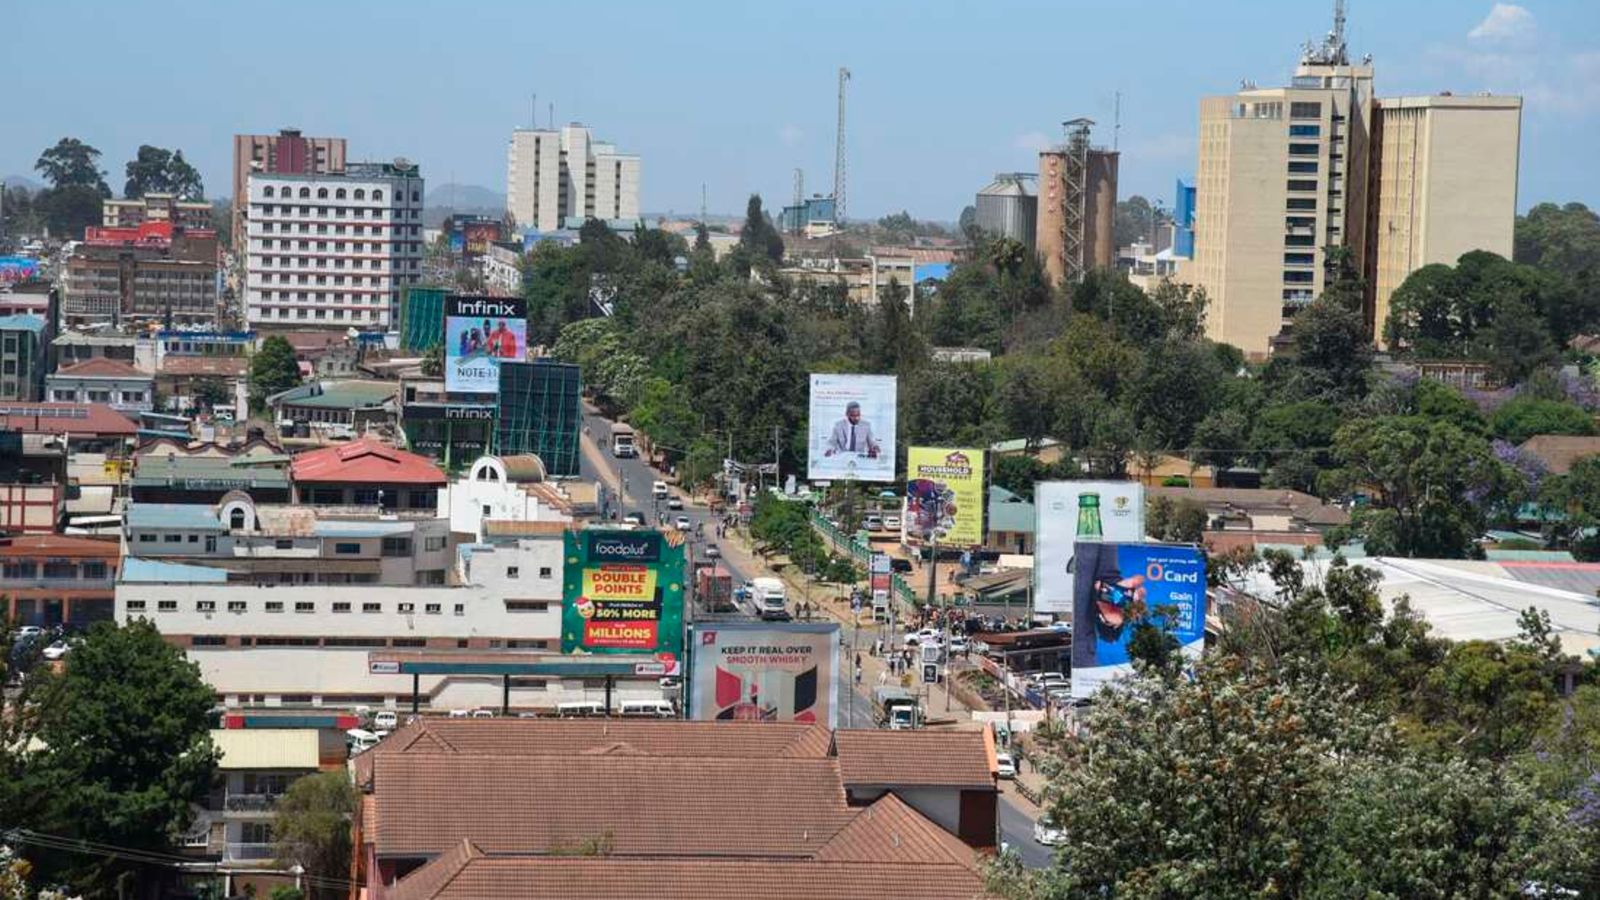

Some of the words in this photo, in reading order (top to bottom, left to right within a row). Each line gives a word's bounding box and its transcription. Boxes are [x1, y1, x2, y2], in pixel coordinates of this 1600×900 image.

[457, 301, 515, 316] Infinix
[445, 407, 492, 419] Infinix
[920, 466, 969, 474] HOUSEHOLD
[595, 543, 646, 555] foodplus
[592, 573, 646, 583] DOUBLE
[595, 584, 643, 594] POINTS
[622, 609, 656, 618] MORE
[589, 628, 651, 638] MILLIONS
[721, 646, 746, 654] KEEP
[747, 646, 758, 654] IT
[759, 646, 783, 654] REAL
[785, 646, 813, 654] OVER
[726, 655, 766, 664] SMOOTH
[768, 655, 807, 664] WHISKY
